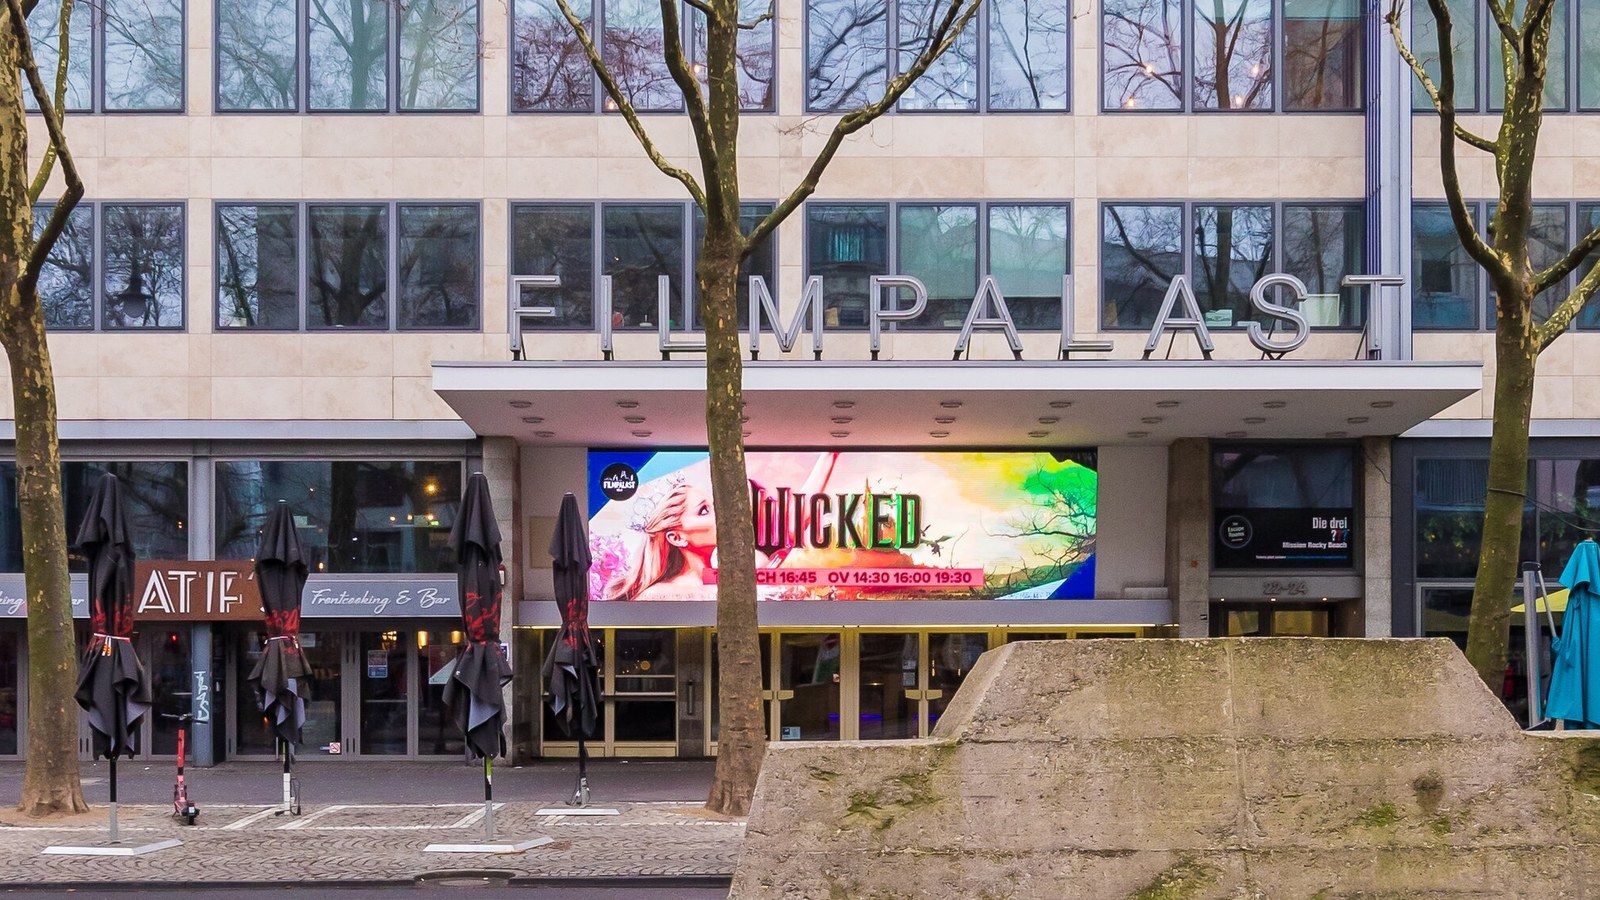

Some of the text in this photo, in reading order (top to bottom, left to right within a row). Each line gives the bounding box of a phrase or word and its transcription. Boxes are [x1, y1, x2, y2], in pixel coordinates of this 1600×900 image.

[509, 272, 1405, 353] FILMPALAST
[749, 478, 922, 557] WICKED
[1312, 516, 1348, 529] Die drei
[1308, 541, 1328, 550] Rocky
[1328, 541, 1348, 549] Beach
[780, 571, 817, 583] 16:45
[828, 571, 850, 583] OV
[853, 571, 890, 583] 14:30
[894, 571, 931, 583] 16:00
[935, 571, 972, 583] 19:30
[310, 587, 451, 615] Frontcooking & Bar
